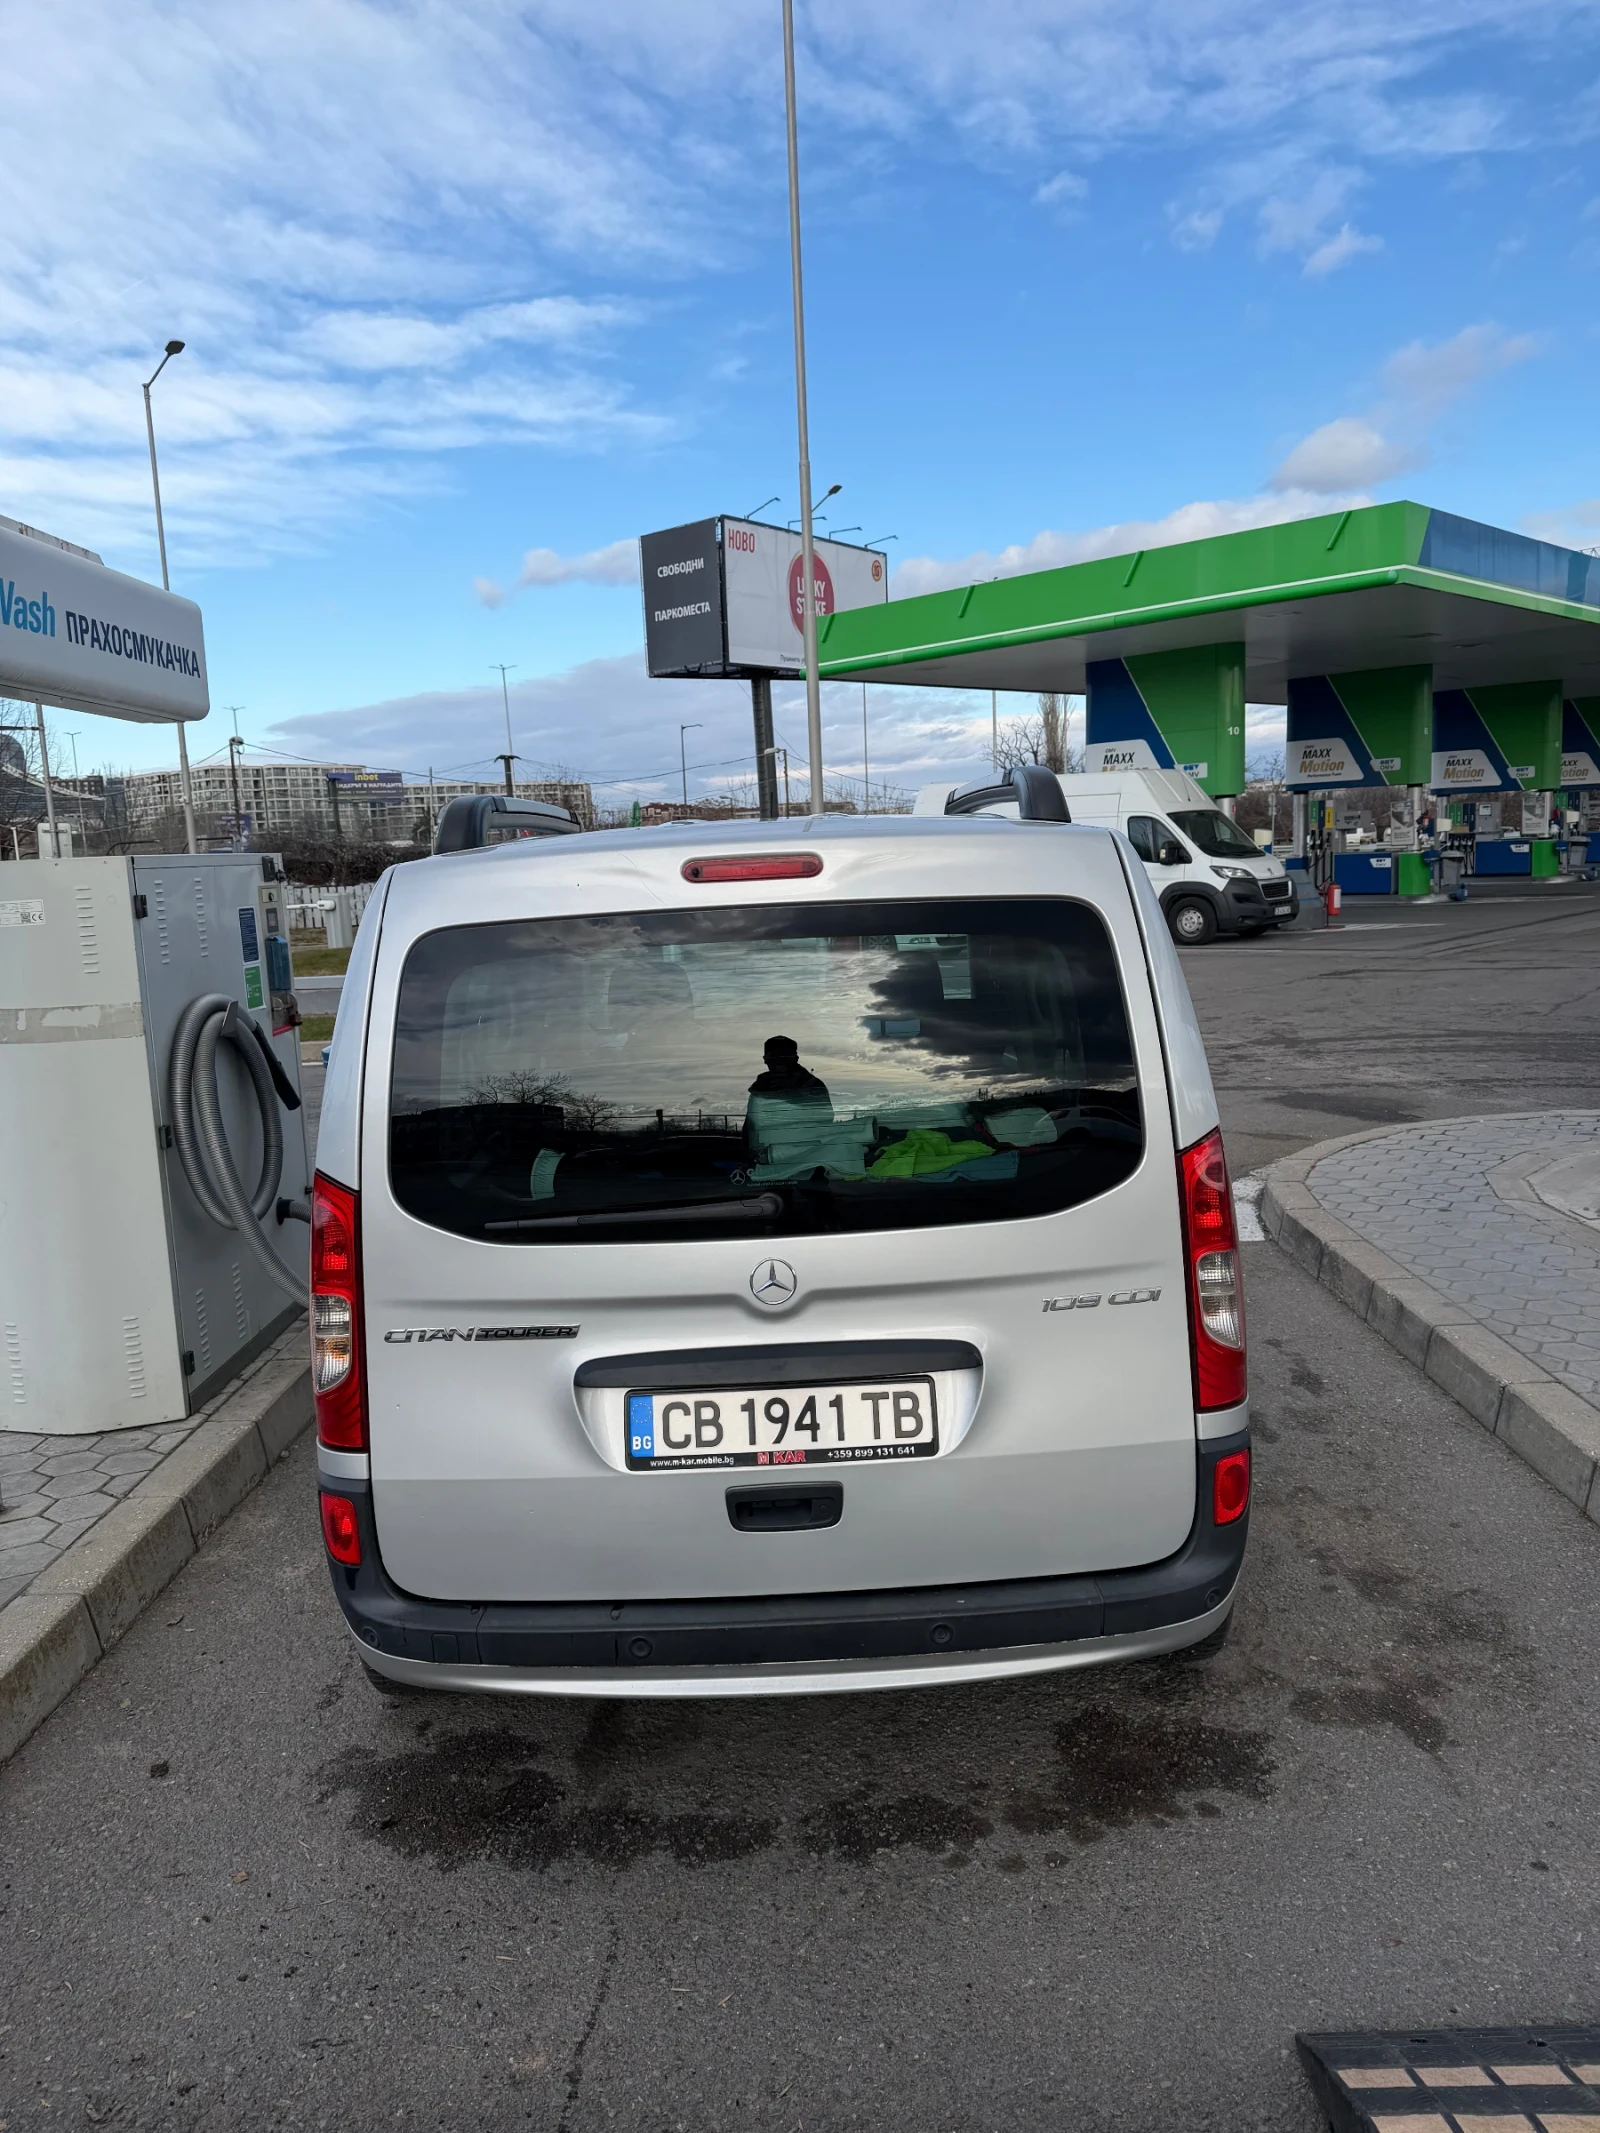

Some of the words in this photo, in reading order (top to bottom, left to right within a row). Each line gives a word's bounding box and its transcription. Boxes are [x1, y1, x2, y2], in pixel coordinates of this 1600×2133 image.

[727, 527, 756, 553] НОВО
[656, 557, 705, 578] СВОБОДНИ
[797, 576, 826, 598] LKY
[654, 601, 711, 622] ПАРКОМЕСТА
[65, 610, 201, 679] ПРАХОСМУКАЧКА
[1227, 726, 1240, 736] 10
[1103, 752, 1136, 765] MAXX
[1302, 748, 1332, 760] MAXX
[1446, 758, 1474, 767] MAXX
[1299, 759, 1345, 774] Motion
[1443, 766, 1485, 780] Motion
[1561, 767, 1589, 777] otion
[354, 773, 379, 781] inbet
[1041, 1292, 1102, 1312] 109
[1108, 1286, 1163, 1306] CDI
[384, 1326, 475, 1344] CITAN
[477, 1325, 577, 1341] TOURER
[632, 1435, 652, 1451] BG
[661, 1399, 724, 1450] CB
[739, 1393, 847, 1446] 1941
[860, 1390, 924, 1440] TB
[649, 1455, 735, 1468] www.m-kar.mobile.bg
[773, 1450, 807, 1464] KAR
[827, 1450, 853, 1460] +359
[854, 1448, 874, 1458] 899
[876, 1447, 896, 1457] 131
[897, 1446, 916, 1455] 641
